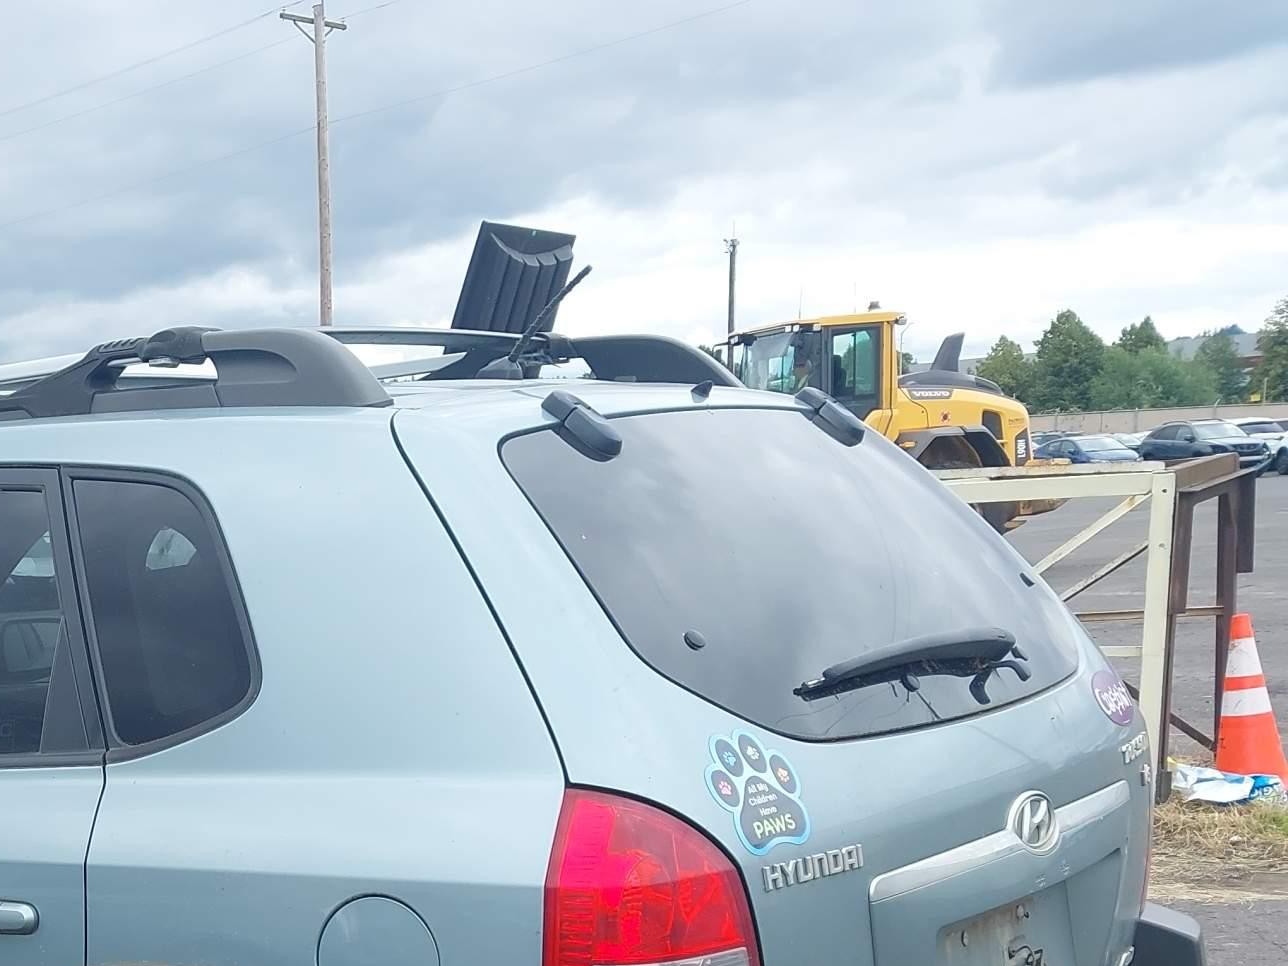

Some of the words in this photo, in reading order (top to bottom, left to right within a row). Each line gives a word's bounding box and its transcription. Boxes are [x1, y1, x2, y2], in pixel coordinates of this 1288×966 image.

[912, 388, 950, 397] VOLVO
[748, 784, 758, 794] All
[757, 783, 769, 793] My
[749, 793, 778, 806] Children
[759, 806, 778, 816] Have
[753, 813, 796, 839] PAWS
[762, 844, 864, 893] HYUNDAI
